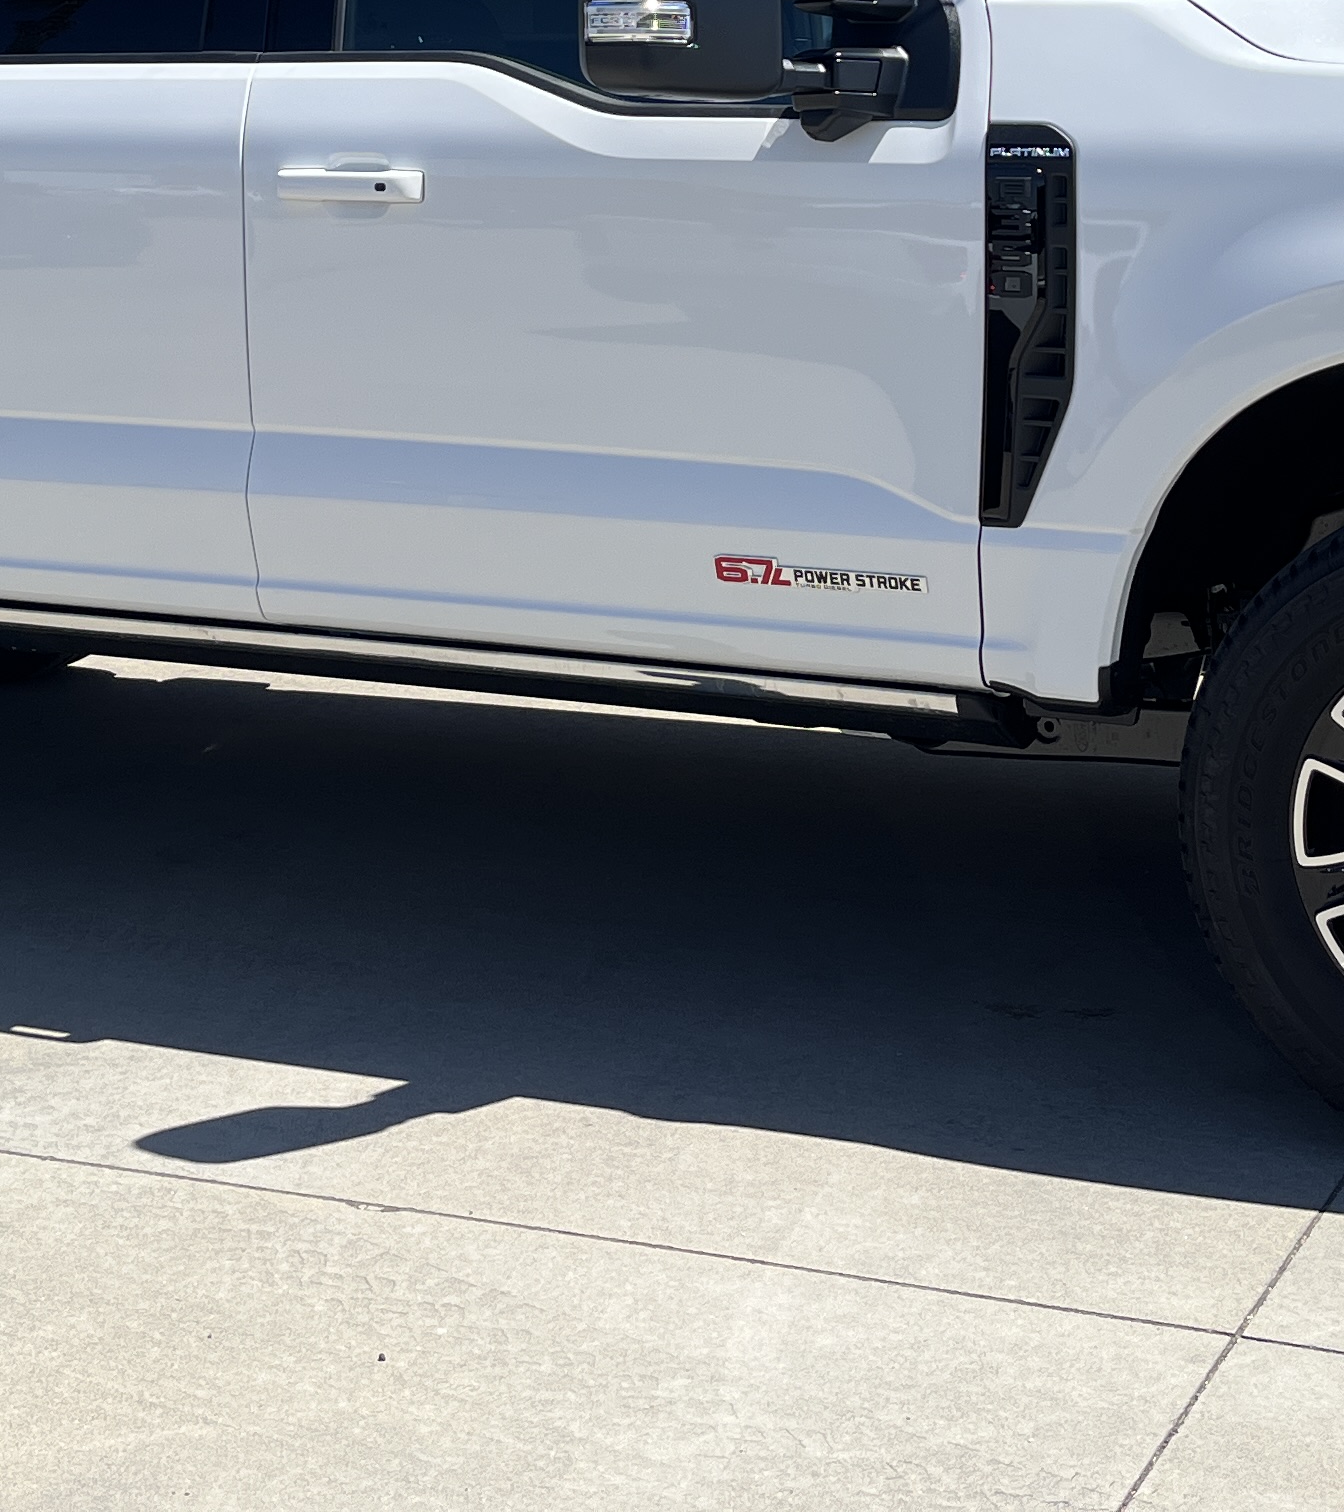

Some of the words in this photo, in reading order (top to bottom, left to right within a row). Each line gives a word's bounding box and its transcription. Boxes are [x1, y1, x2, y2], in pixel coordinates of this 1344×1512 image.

[990, 146, 1070, 158] PLATINUM
[714, 555, 792, 587] 6.7L
[793, 569, 851, 587] POWER
[855, 574, 922, 592] STROKE
